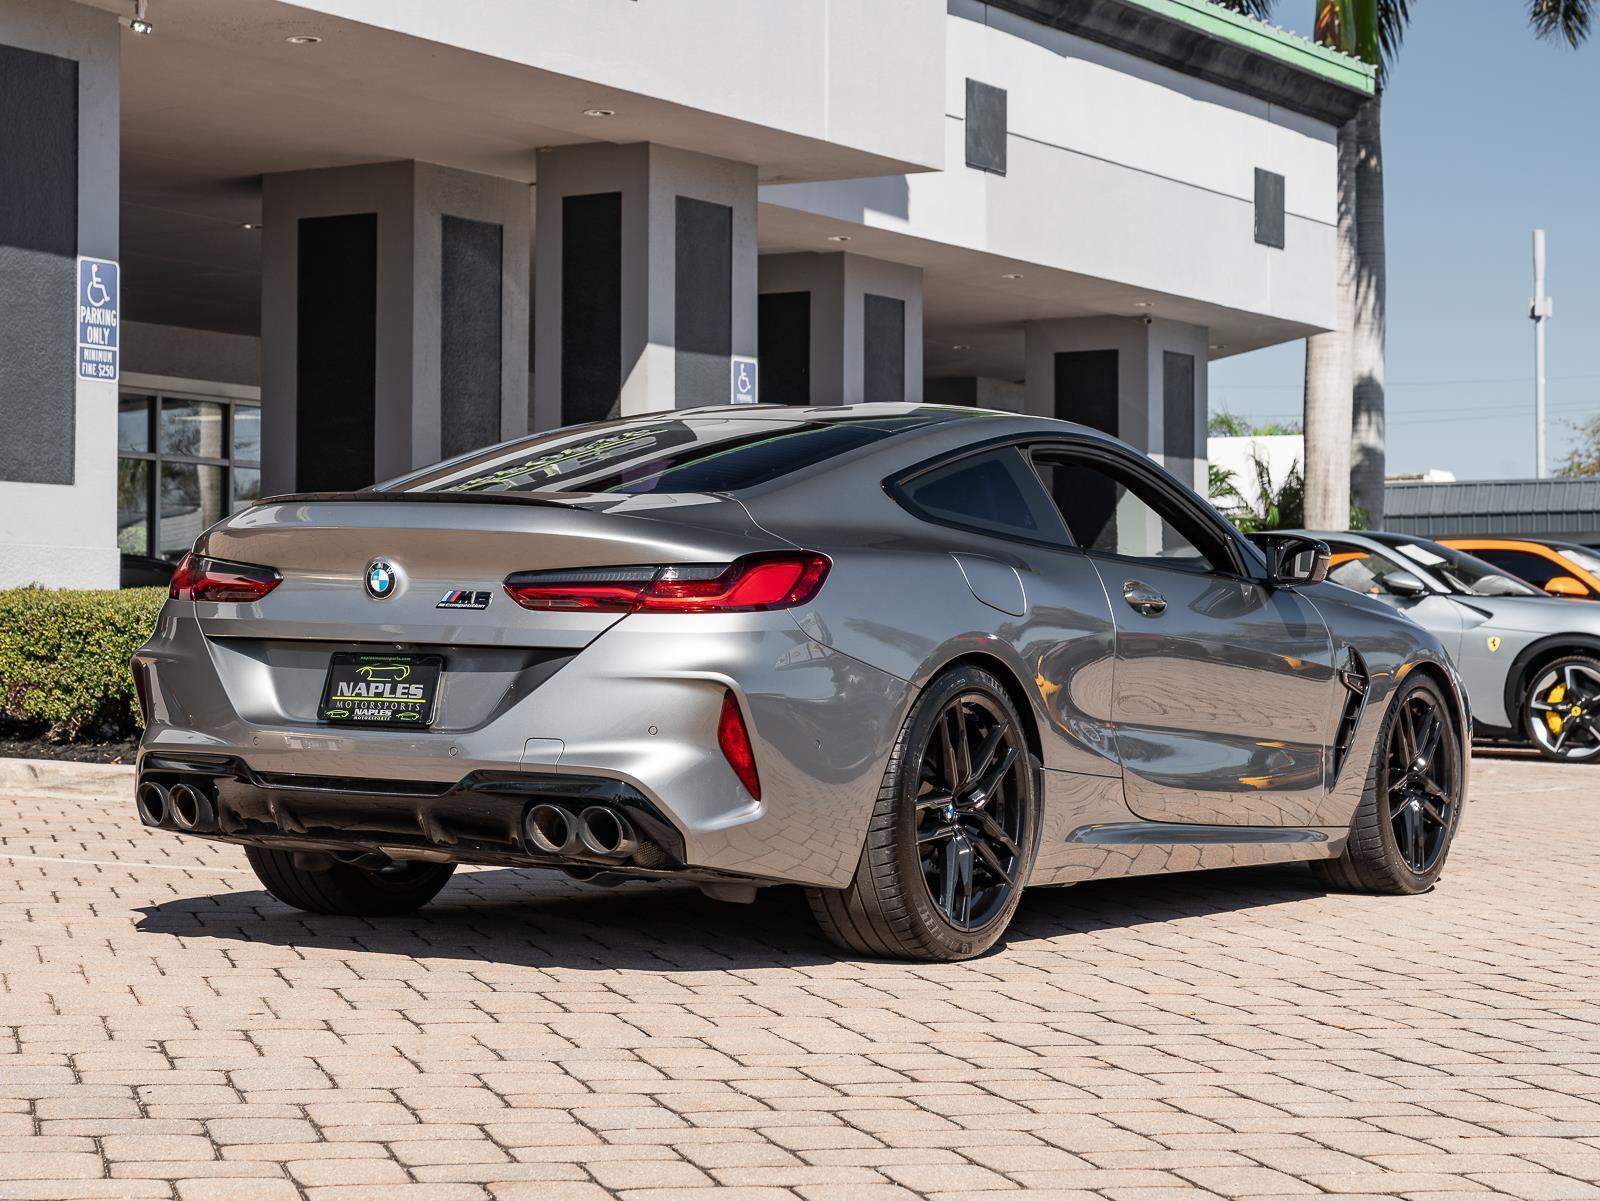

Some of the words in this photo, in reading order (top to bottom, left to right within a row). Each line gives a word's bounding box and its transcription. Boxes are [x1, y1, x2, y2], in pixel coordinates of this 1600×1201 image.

[80, 306, 116, 327] PARKING
[87, 326, 110, 344] ONLY
[84, 349, 112, 363] MINIMUM
[82, 362, 97, 376] FINE
[98, 362, 114, 377] $250
[337, 682, 424, 698] NAPLES
[335, 701, 420, 711] MOTORSPORTS
[354, 708, 393, 716] NAPLES
